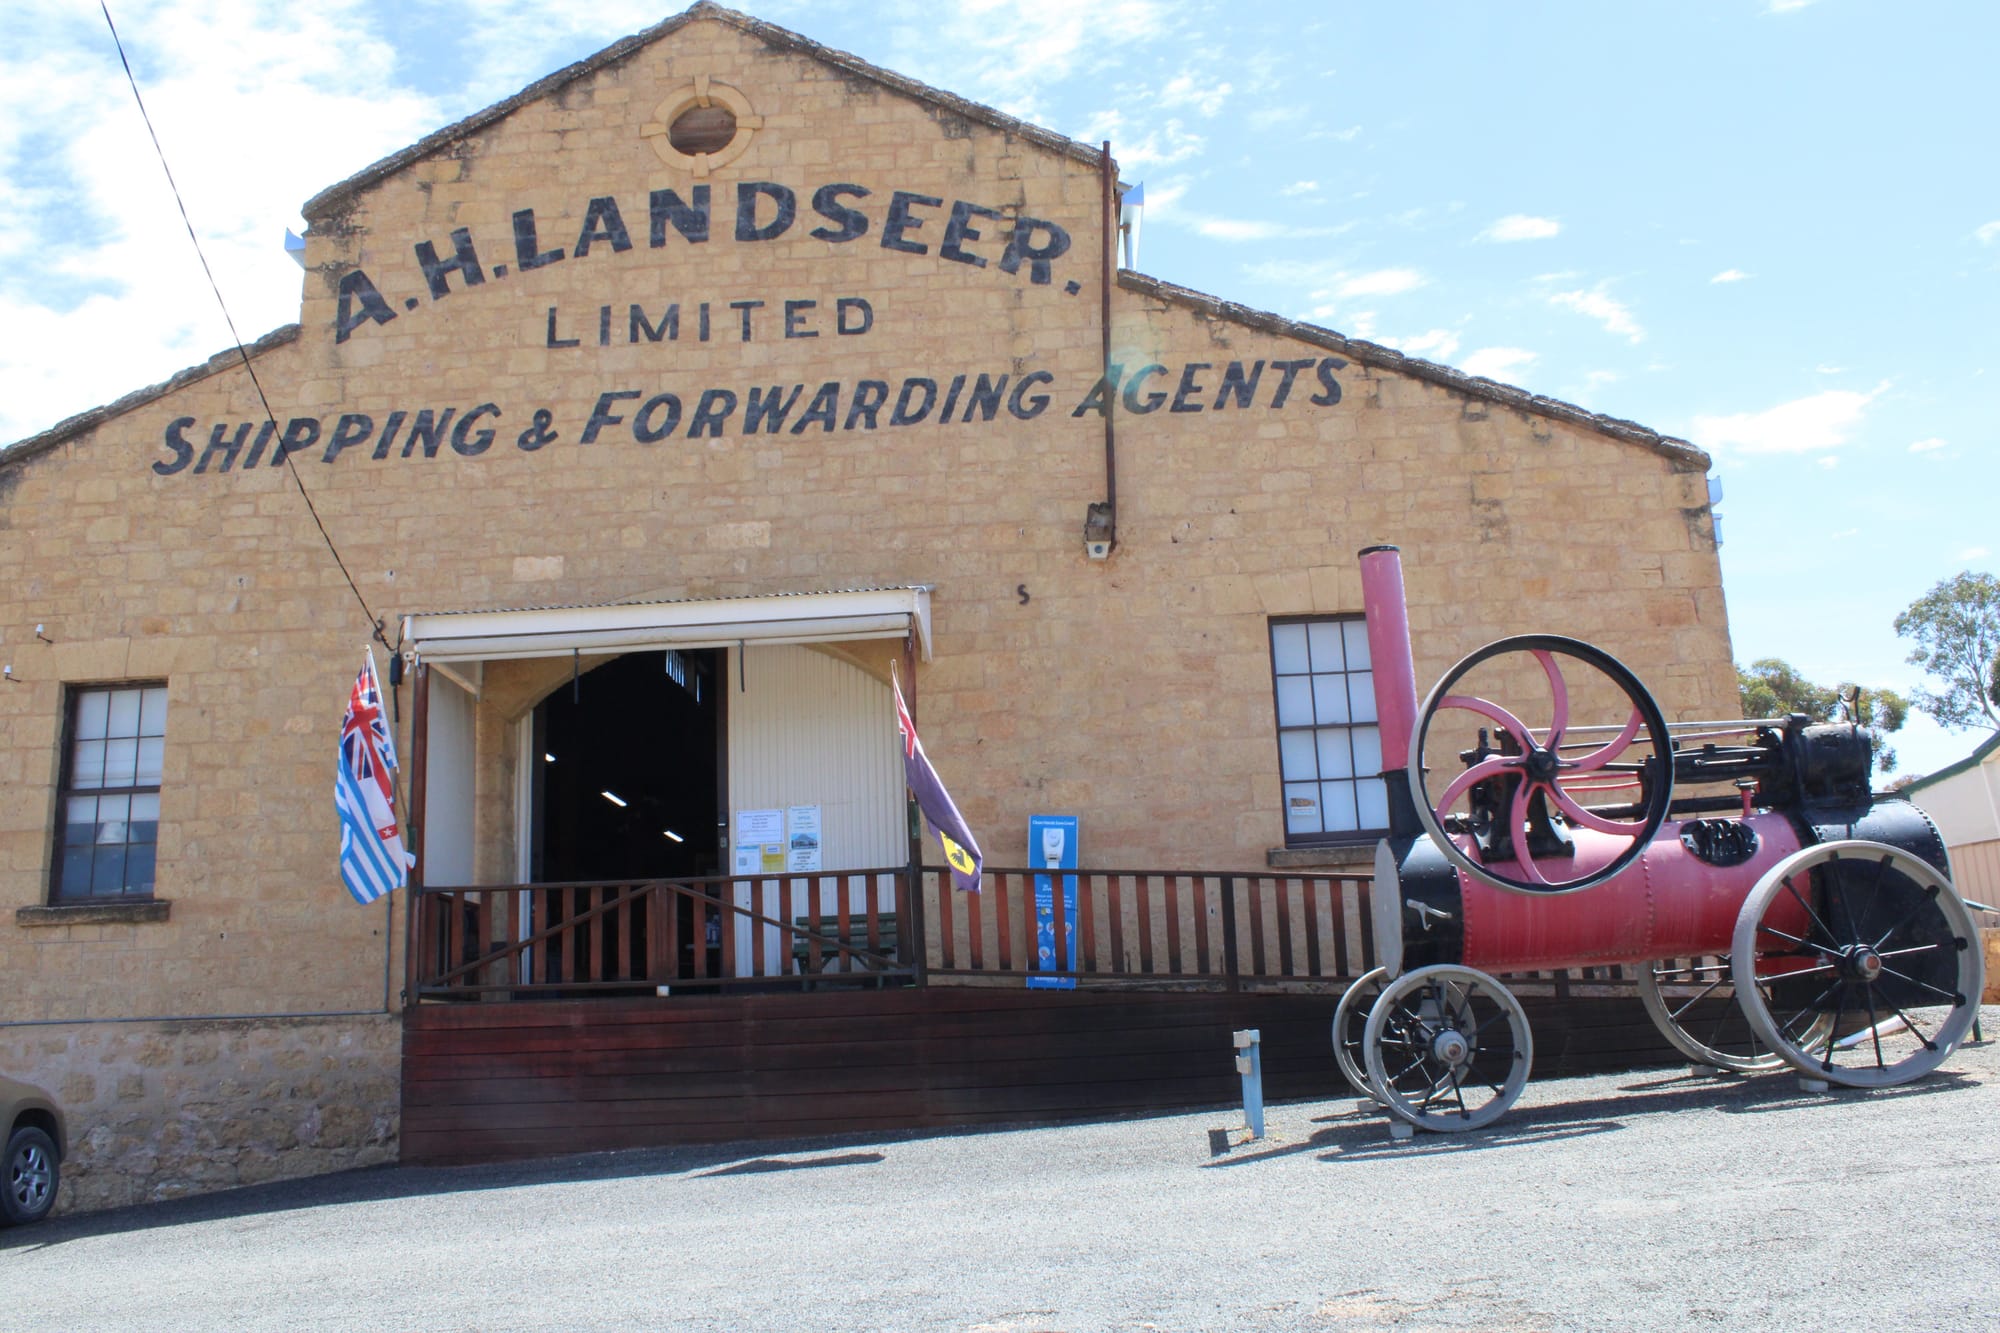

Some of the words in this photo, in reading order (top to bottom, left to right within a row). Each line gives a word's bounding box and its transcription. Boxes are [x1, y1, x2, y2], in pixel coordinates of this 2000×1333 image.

[546, 297, 875, 349] LIMITED
[152, 402, 502, 475] SHIPPING
[516, 408, 559, 453] &
[579, 370, 1054, 445] FORWARDING
[1071, 357, 1349, 418] AGENTS
